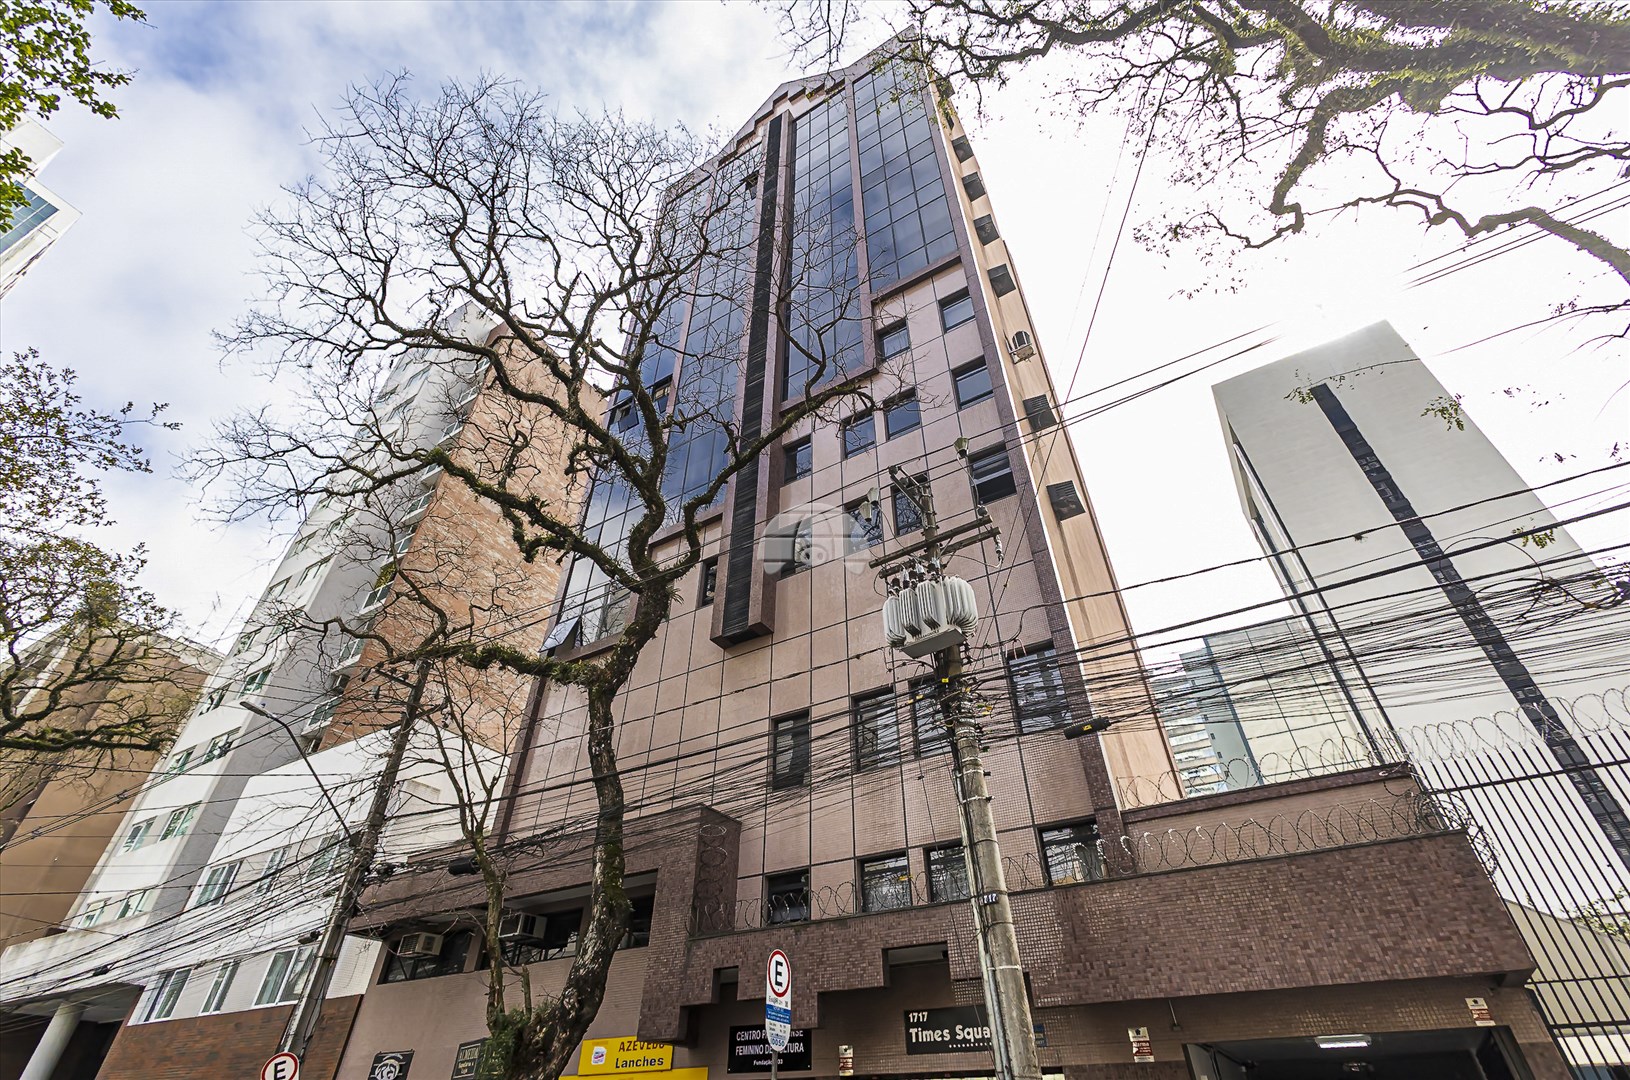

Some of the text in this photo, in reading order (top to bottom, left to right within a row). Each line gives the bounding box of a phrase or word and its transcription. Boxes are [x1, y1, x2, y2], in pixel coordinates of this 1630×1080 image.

[775, 960, 783, 987] E
[909, 1011, 928, 1023] 1717
[736, 1029, 761, 1041] CENTRO
[909, 1024, 992, 1043] Times Squa
[735, 1044, 764, 1056] FEMININO
[765, 1043, 773, 1054] DE
[615, 1056, 664, 1069] Lanches
[274, 1060, 287, 1080] E
